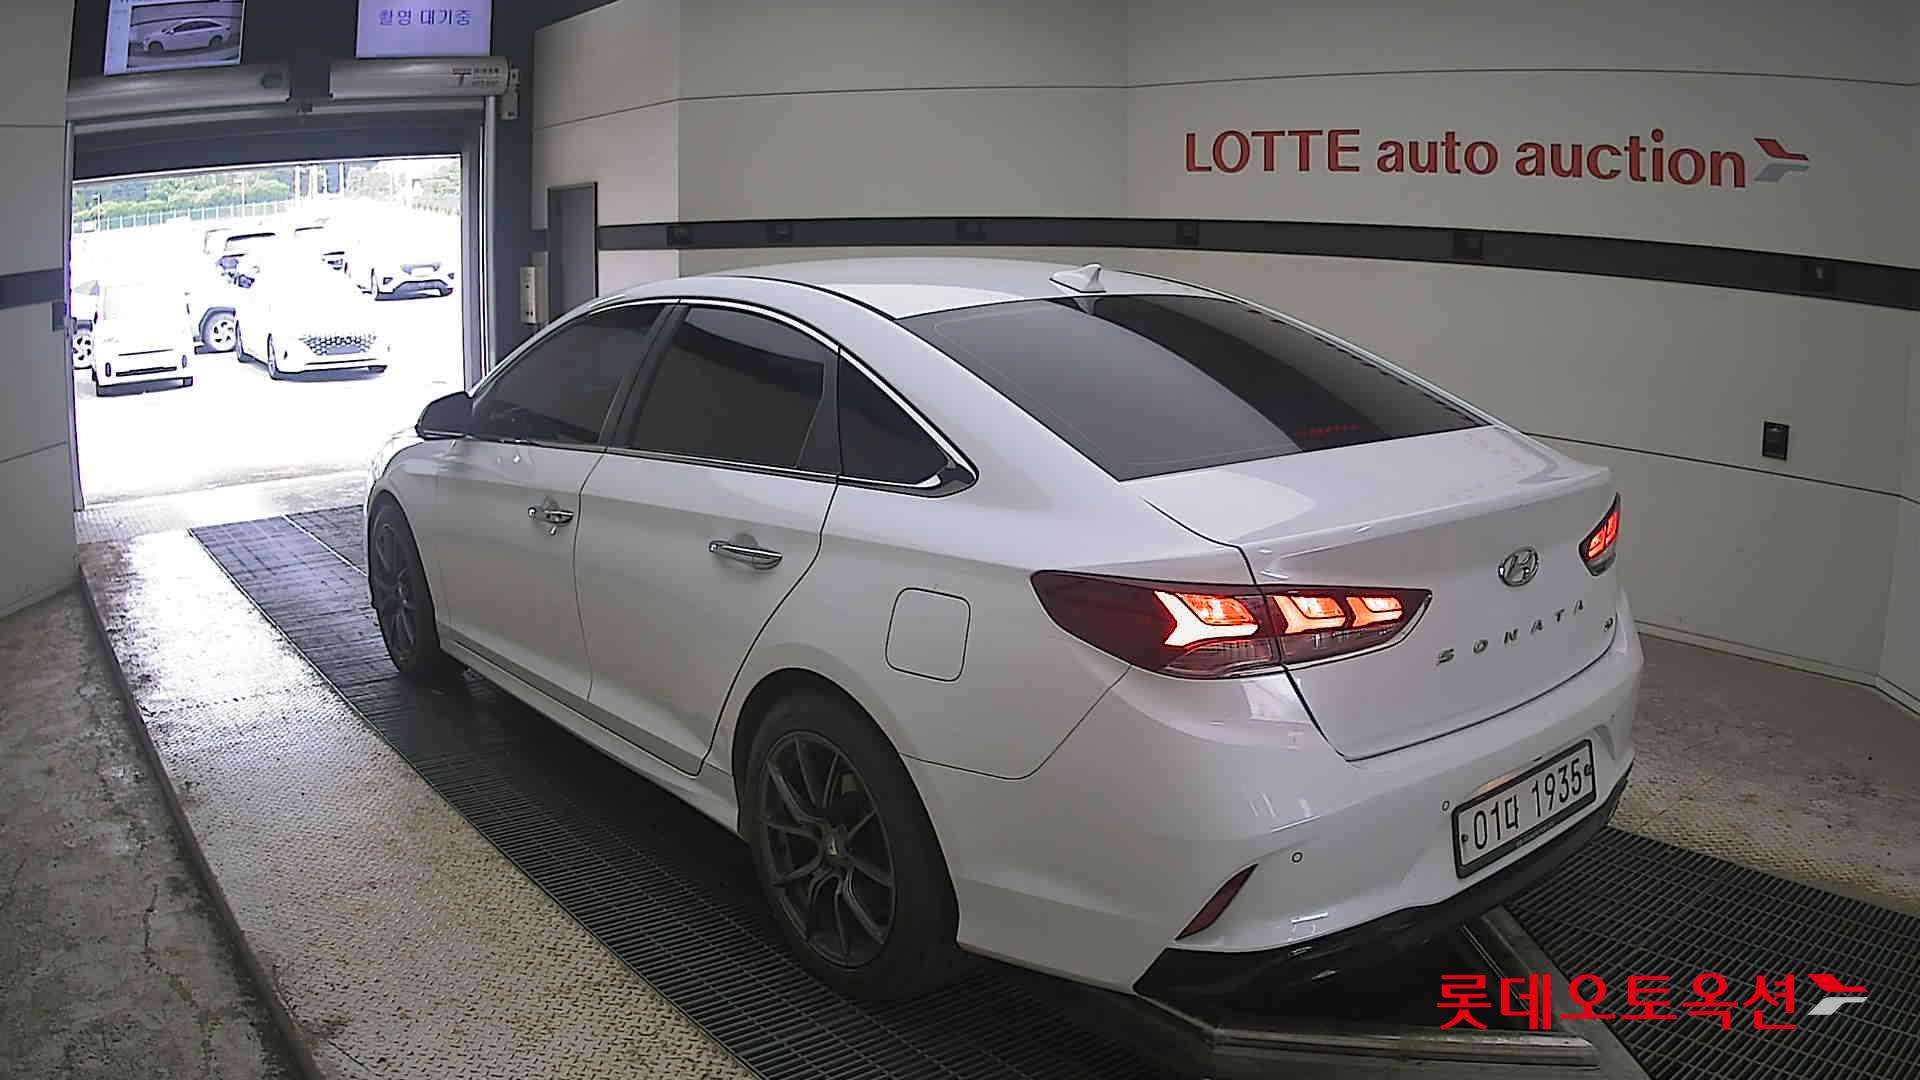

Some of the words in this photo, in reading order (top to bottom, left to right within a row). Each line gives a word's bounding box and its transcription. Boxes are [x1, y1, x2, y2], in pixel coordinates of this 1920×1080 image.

[379, 8, 412, 26] 촬영
[420, 8, 472, 26] 대기중
[1185, 129, 1361, 174] LOTTE
[1376, 131, 1499, 176] auto
[1515, 129, 1746, 189] auction
[1436, 599, 1584, 665] SONATA
[1473, 795, 1519, 850] 01다
[1532, 758, 1583, 818] 1935
